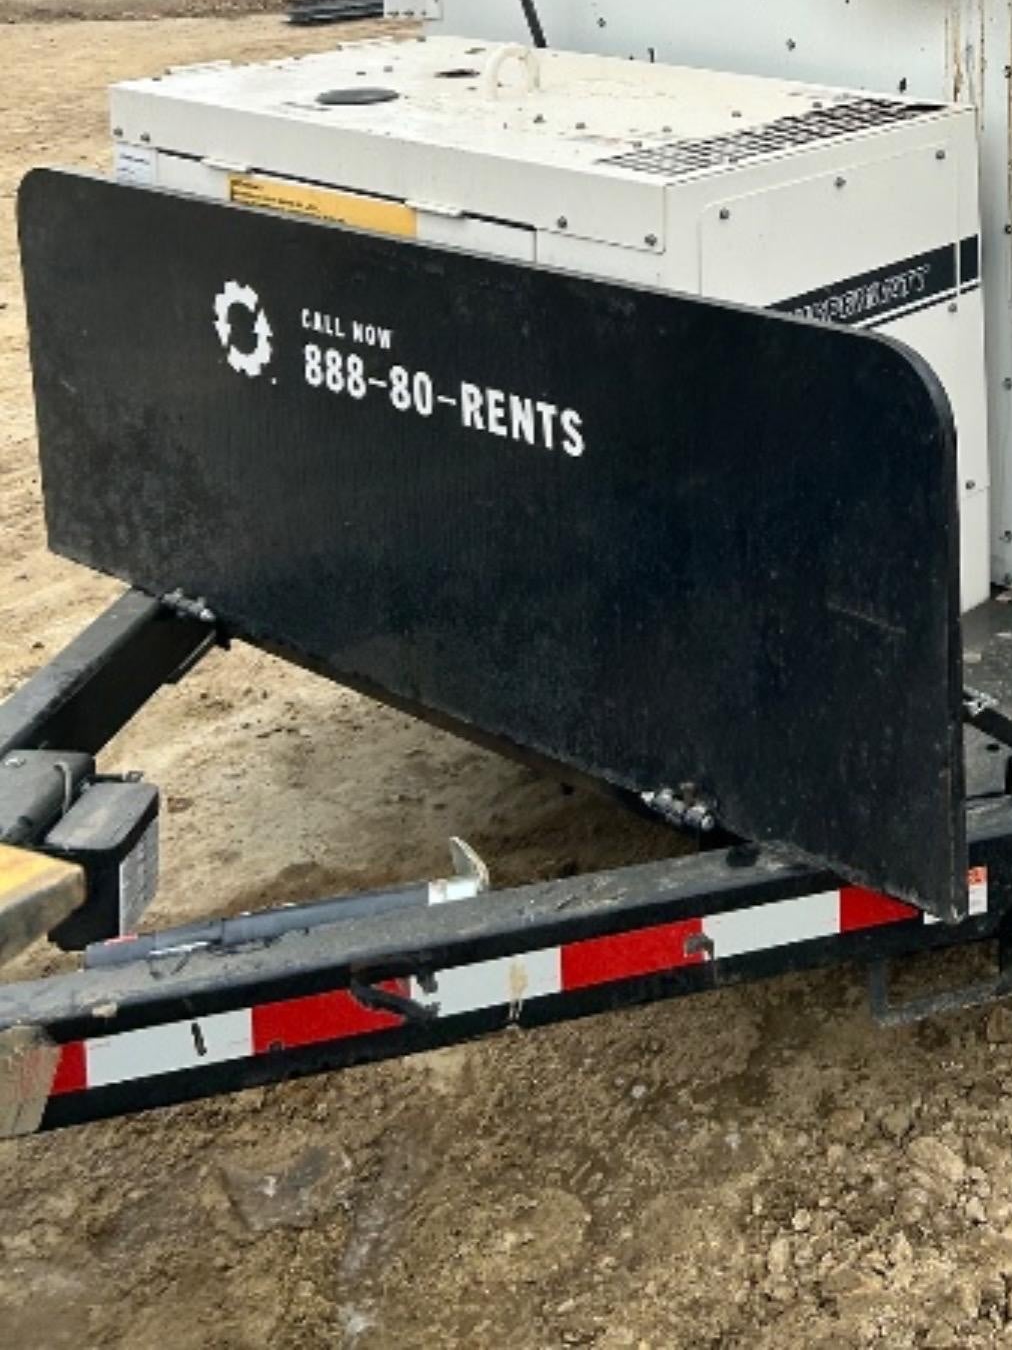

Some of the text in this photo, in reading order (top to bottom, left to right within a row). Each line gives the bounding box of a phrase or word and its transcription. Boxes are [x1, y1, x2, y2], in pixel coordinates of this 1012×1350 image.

[301, 308, 395, 349] CALL NOW
[304, 343, 585, 458] 888-80-RENTS
